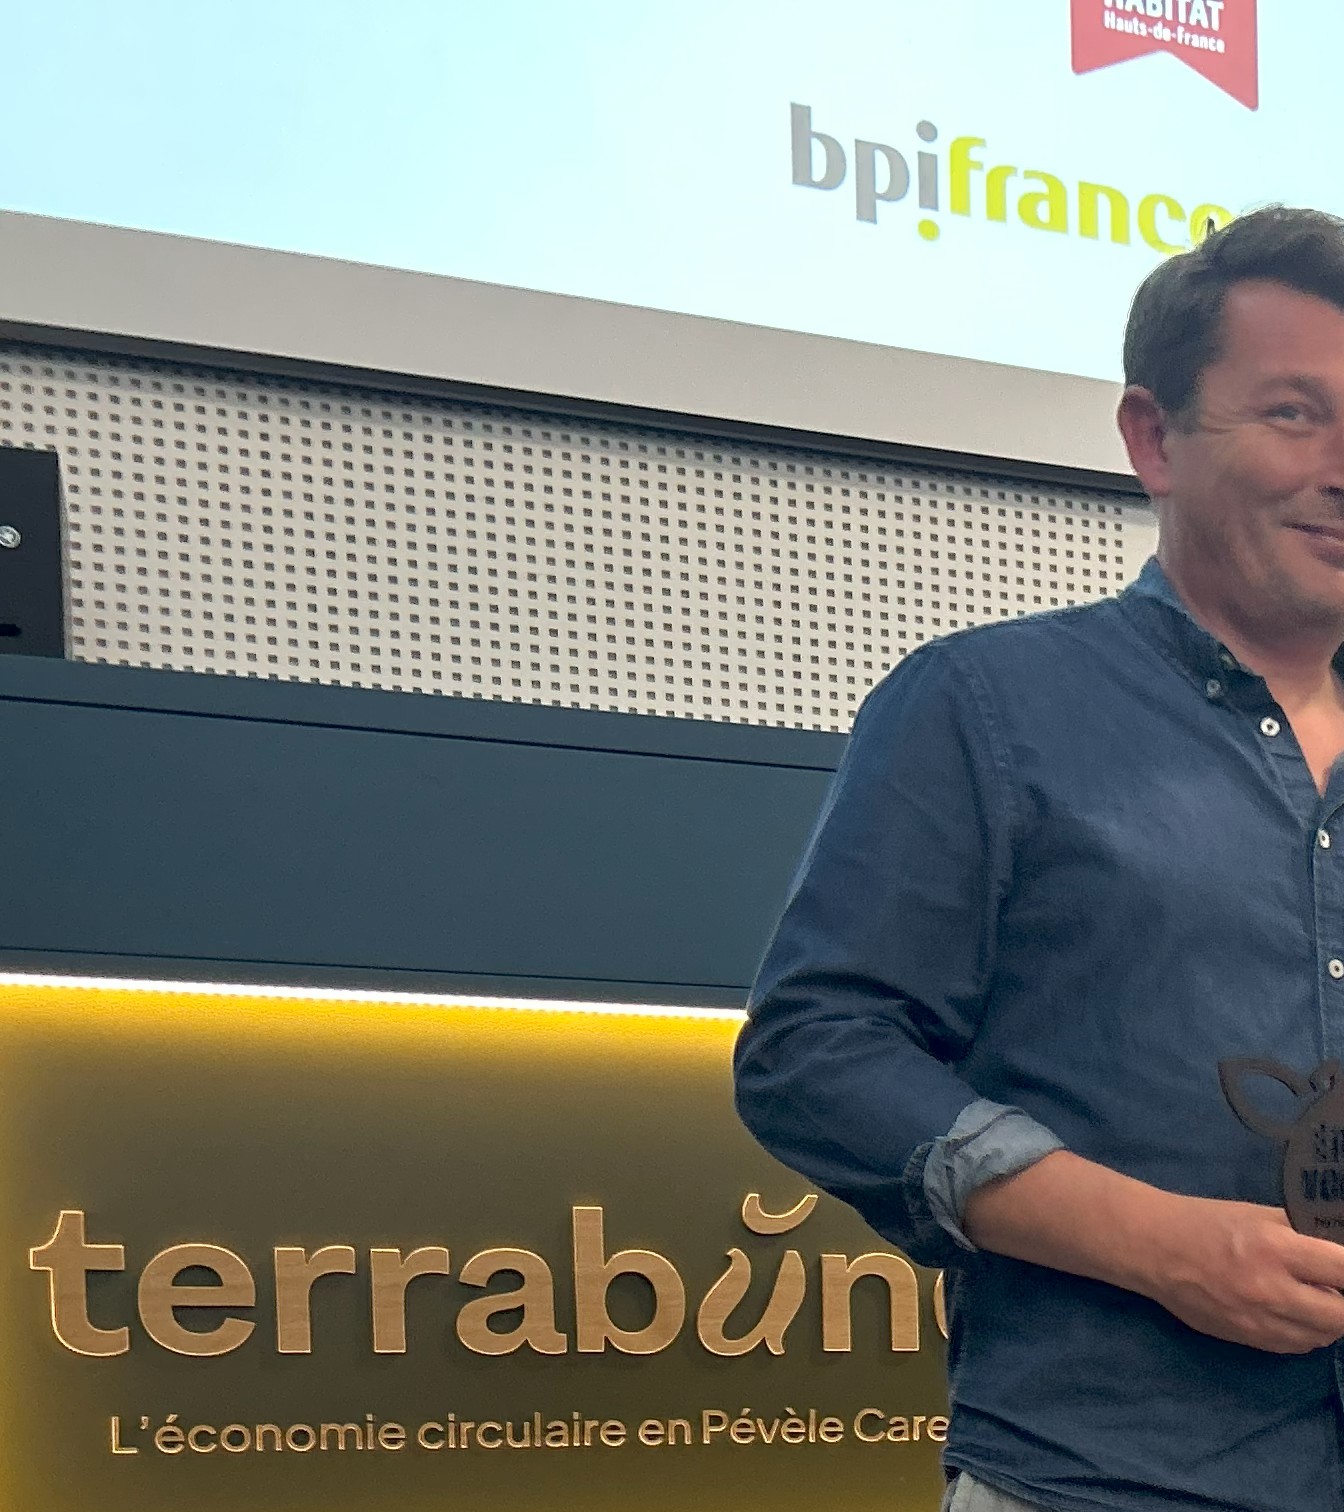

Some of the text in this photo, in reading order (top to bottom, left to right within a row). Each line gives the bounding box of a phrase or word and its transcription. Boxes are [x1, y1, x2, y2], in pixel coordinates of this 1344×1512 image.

[1103, 10, 1226, 53] Hauts-de-France
[1104, 0, 1224, 31] BITAT
[111, 1406, 949, 1455] L'économie circulaire en Pévèle Care
